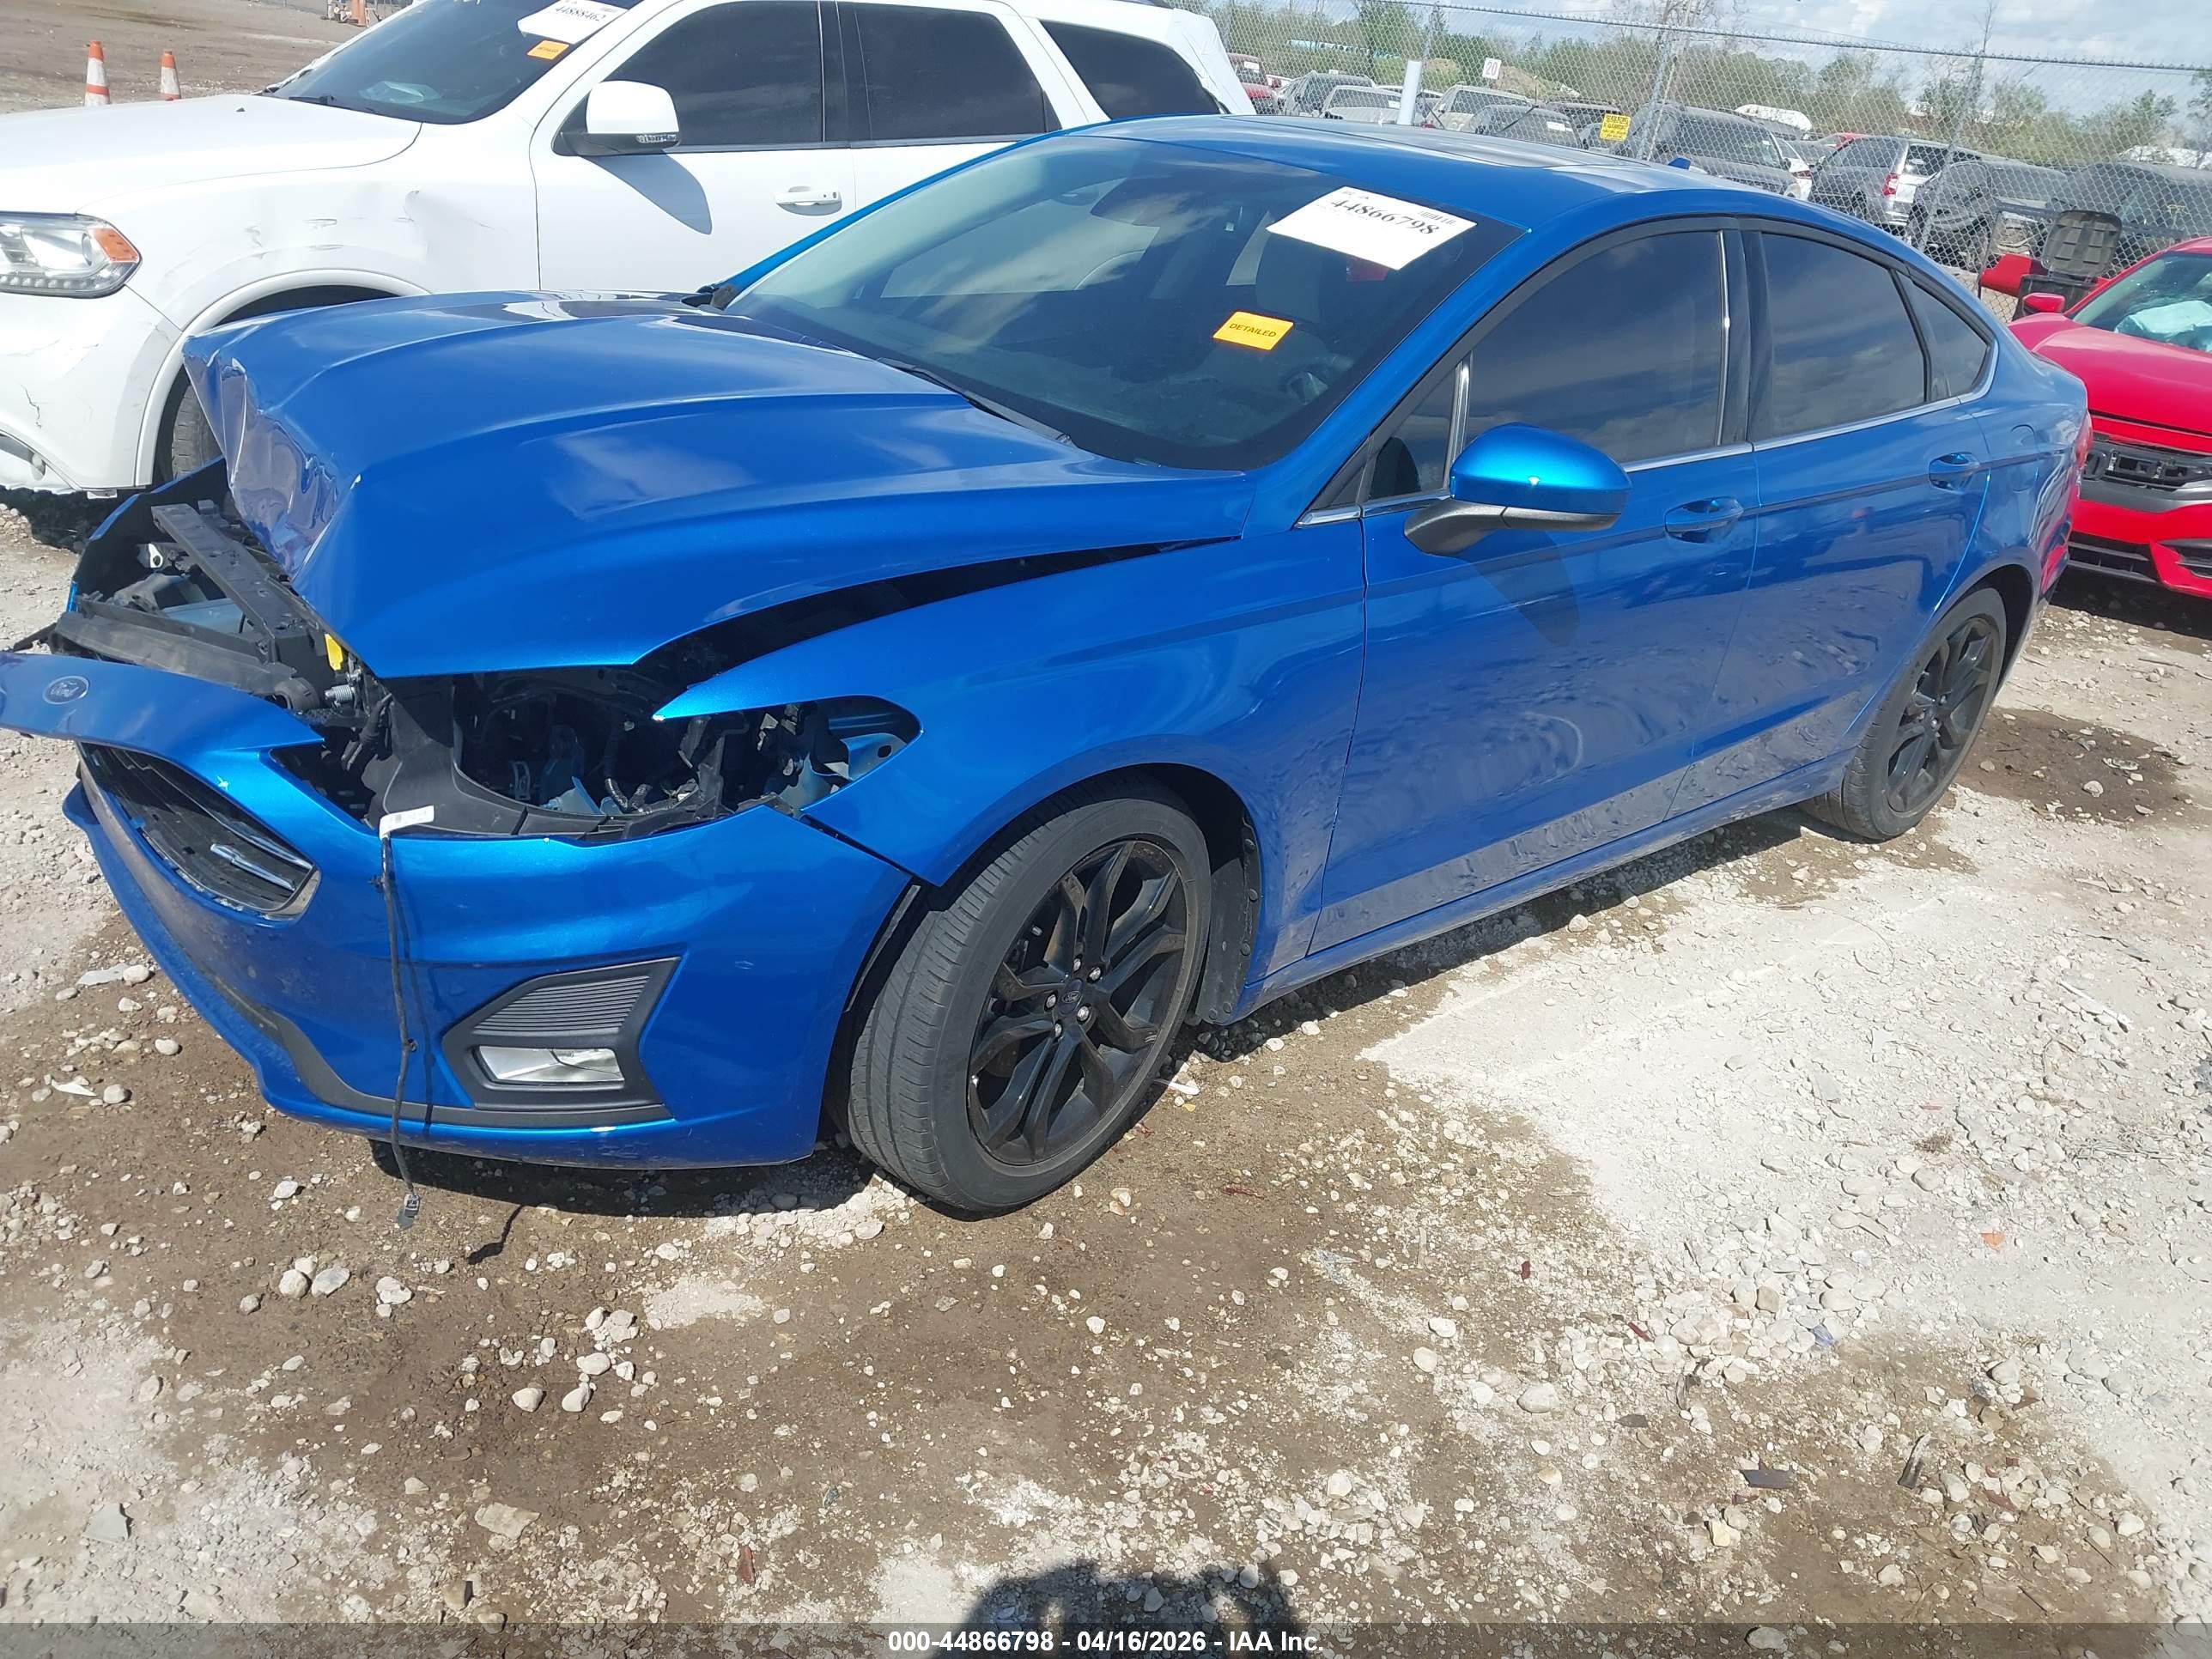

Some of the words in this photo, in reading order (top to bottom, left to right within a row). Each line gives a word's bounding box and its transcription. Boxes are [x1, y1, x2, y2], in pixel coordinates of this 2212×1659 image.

[1485, 61, 1498, 76] 20
[1331, 199, 1439, 234] 44866798
[1229, 323, 1277, 337] DETAILED
